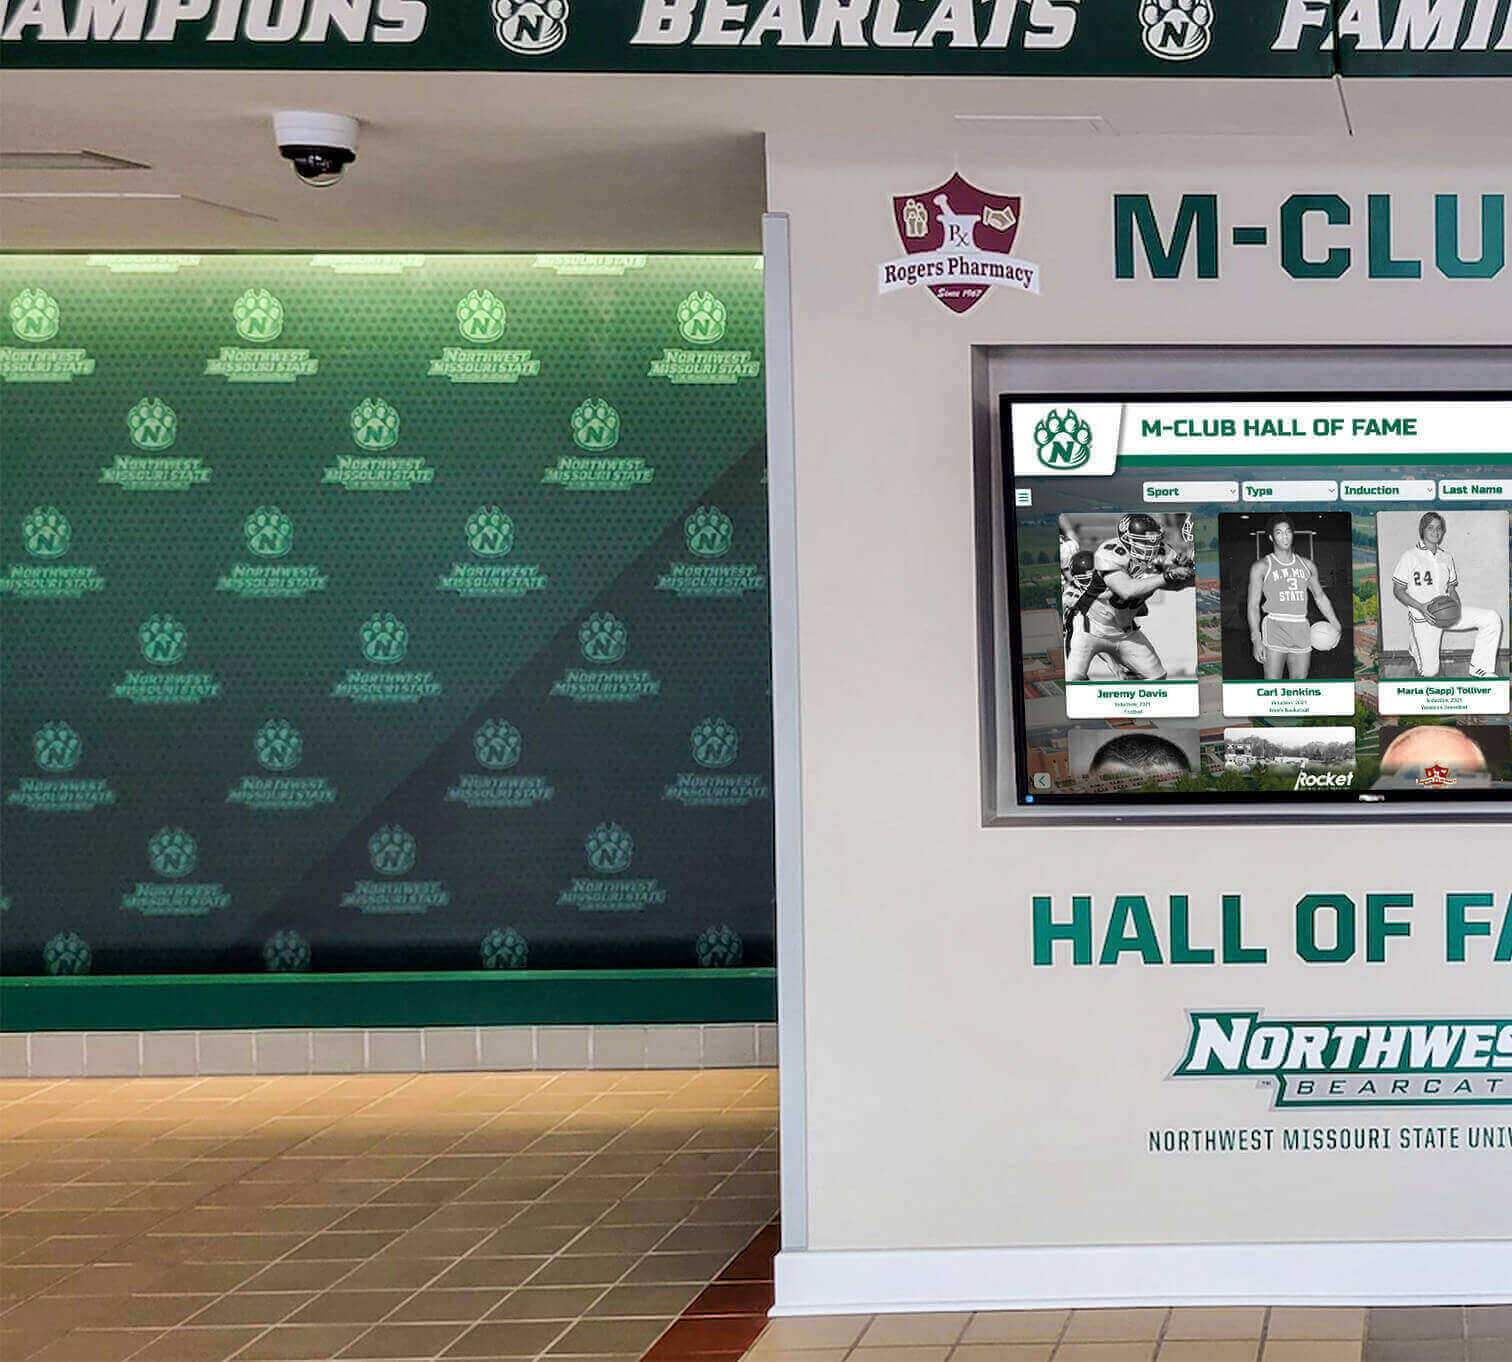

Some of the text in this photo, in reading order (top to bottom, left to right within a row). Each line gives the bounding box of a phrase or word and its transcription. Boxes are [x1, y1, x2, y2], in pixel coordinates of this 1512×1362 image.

[0, 0, 428, 42] AMPIONS
[512, 15, 545, 41] N
[629, 0, 1080, 49] BEARCATS
[1157, 22, 1192, 47] N
[884, 255, 1034, 289] Rogers Pharmacy
[24, 316, 43, 335] N
[248, 316, 267, 335] N
[470, 317, 490, 336] N
[691, 318, 710, 337] N
[0, 349, 80, 362] NORTHWEST
[223, 349, 305, 362] NORTHWEST
[445, 350, 527, 363] NORTHWEST
[666, 350, 748, 364] NORTHWEST
[142, 424, 160, 444] N
[364, 424, 384, 444] N
[585, 425, 604, 444] N
[1141, 417, 1417, 438] M-CLUB HALL OF FAME
[1048, 440, 1075, 463] N
[116, 457, 198, 470] NORTHWEST
[339, 457, 421, 470] NORTHWEST
[560, 457, 642, 471] NORTHWEST
[1146, 486, 1179, 498] Sport
[1245, 485, 1273, 498] Type
[1344, 483, 1400, 496] Induction
[1442, 483, 1503, 495] Last Name
[36, 532, 55, 551] N
[259, 532, 278, 551] N
[479, 532, 498, 551] N
[698, 532, 717, 550] N
[11, 564, 93, 578] NORTHWEST
[233, 564, 315, 578] NORTHWEST
[454, 564, 536, 578] NORTHWEST
[673, 564, 755, 578] NORTHWEST
[1413, 570, 1433, 586] 24
[1287, 577, 1298, 590] 3
[1279, 590, 1305, 602] STATE
[1097, 688, 1168, 700] Jeremy Davis
[1256, 687, 1322, 697] Carl Jenkins
[1456, 686, 1492, 695] Tolliver
[1294, 771, 1354, 790] Rocket
[1031, 893, 1268, 966] HALL
[1295, 892, 1415, 964] OF
[1149, 1128, 1275, 1151] NORTHWEST
[1283, 1127, 1391, 1150] MISSOURI
[1399, 1126, 1460, 1149] STATE
